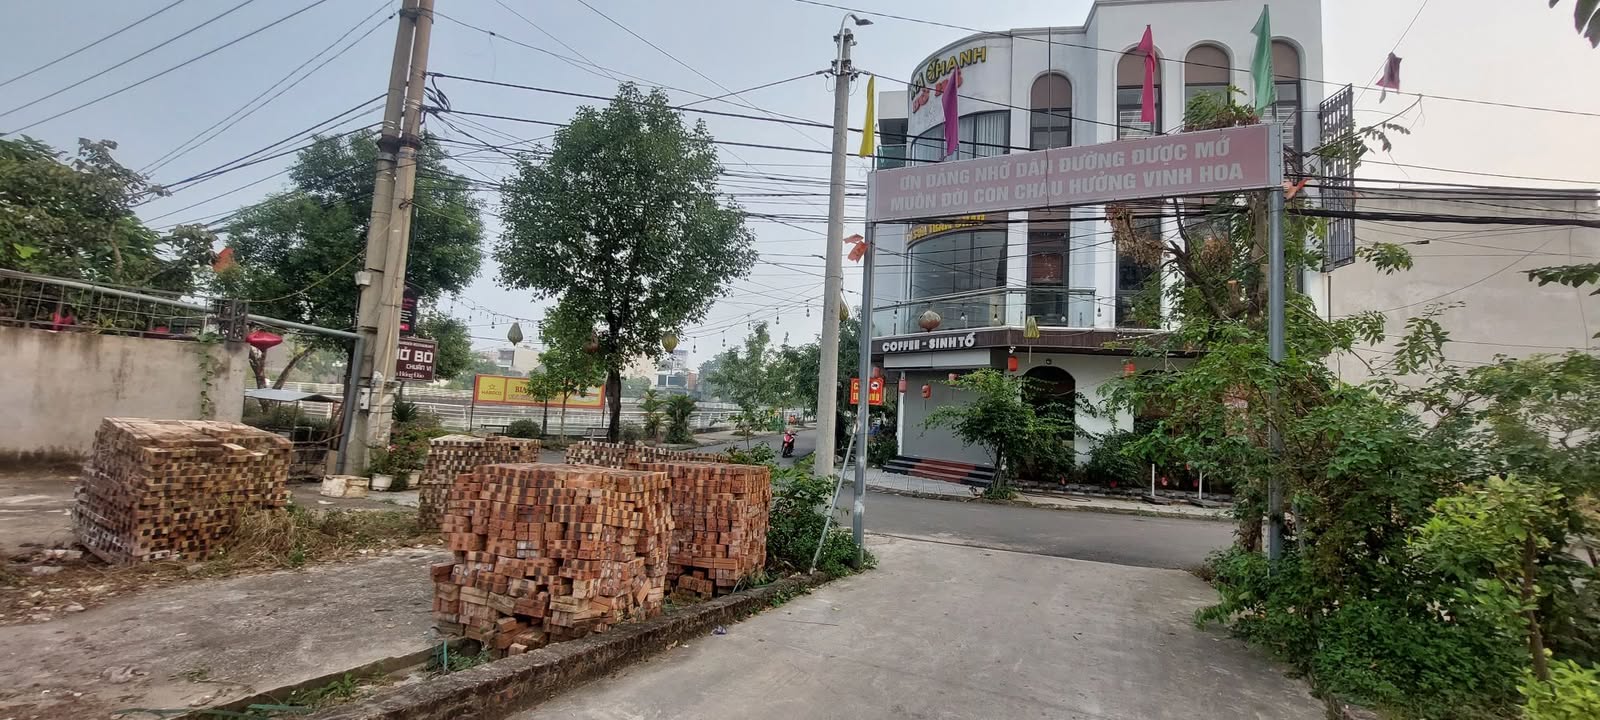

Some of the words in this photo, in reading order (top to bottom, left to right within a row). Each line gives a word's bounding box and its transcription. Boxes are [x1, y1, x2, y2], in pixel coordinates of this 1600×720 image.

[1059, 150, 1125, 173] ĐƯỜNG
[1132, 143, 1187, 166] ĐƯỢC
[974, 186, 1009, 203] CON
[1014, 179, 1063, 200] CHÁU
[1069, 170, 1136, 194] HƯỞNG
[1143, 168, 1192, 188] VINH
[1199, 163, 1243, 183] HOA
[414, 349, 433, 364] BÒ
[882, 339, 920, 352] COFFEE
